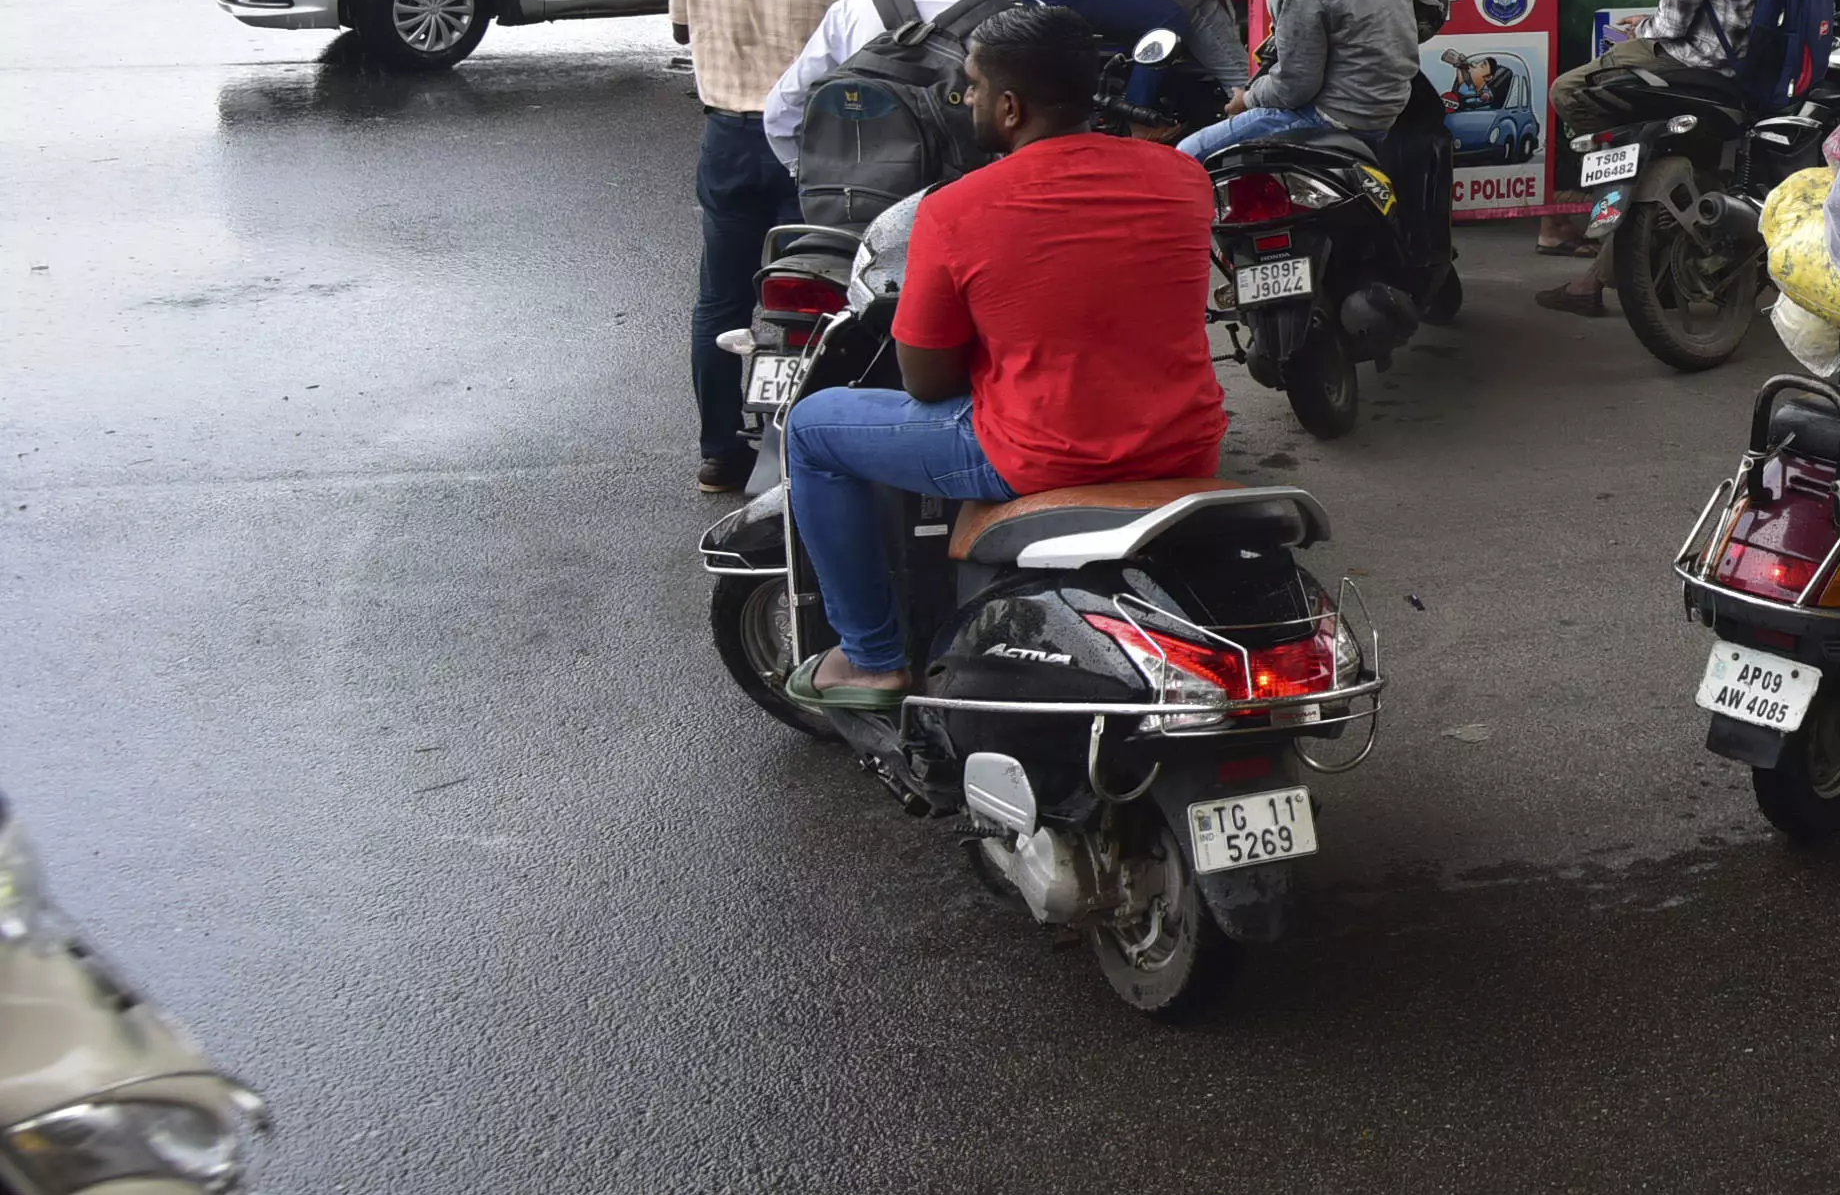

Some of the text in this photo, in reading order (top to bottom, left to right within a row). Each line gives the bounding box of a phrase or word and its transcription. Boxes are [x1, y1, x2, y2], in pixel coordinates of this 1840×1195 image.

[1595, 151, 1627, 166] TS08
[1585, 162, 1634, 183] HD6482
[1470, 176, 1536, 201] POLICE
[1260, 252, 1290, 262] HONDA
[1250, 260, 1302, 283] TS09F
[1251, 276, 1303, 300] J9044
[982, 643, 1073, 665] ACTIVA
[1737, 664, 1783, 693] AP09
[1714, 685, 1789, 723] AW 4085
[1213, 795, 1295, 833] TG 11
[1226, 825, 1294, 862] 5269
